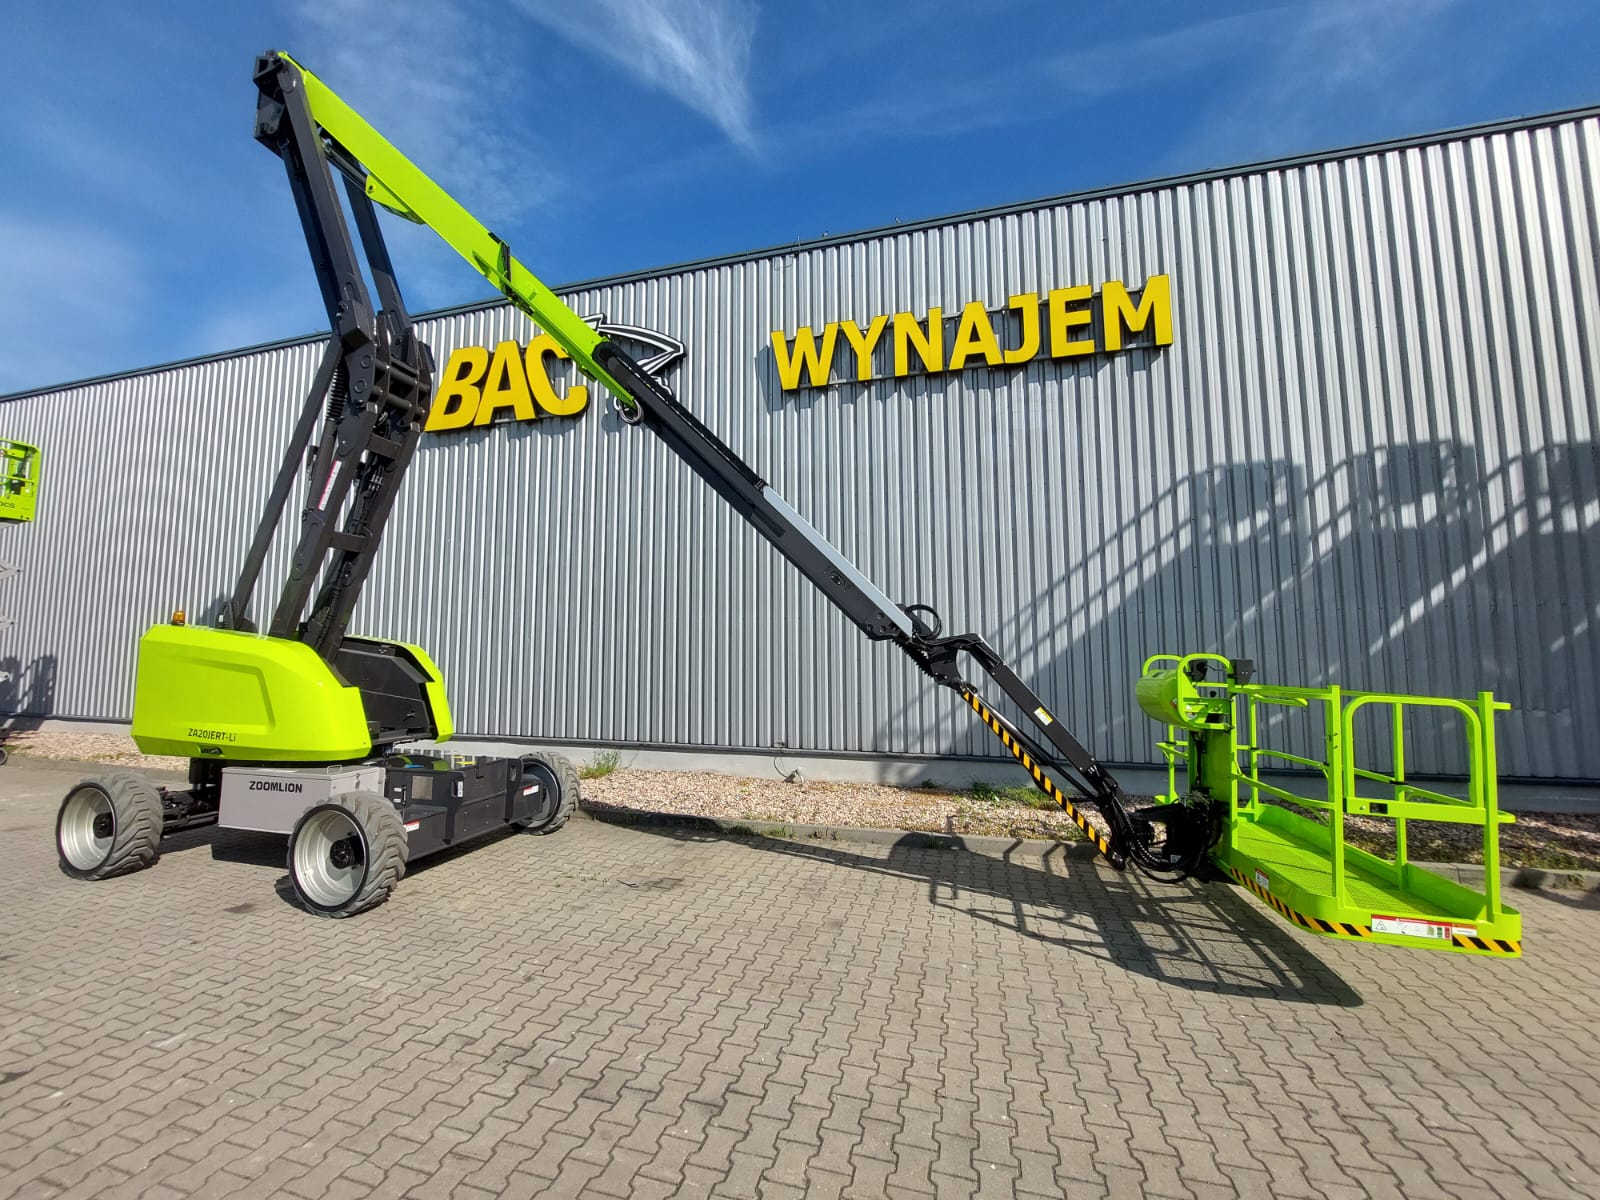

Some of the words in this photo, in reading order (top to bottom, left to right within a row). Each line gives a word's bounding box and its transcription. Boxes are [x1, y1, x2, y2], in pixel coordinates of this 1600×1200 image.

[771, 274, 1173, 391] WYNAJEM
[424, 334, 588, 432] BAC
[188, 728, 238, 742] ZA20JERT-Li
[249, 780, 303, 793] ZOOMLION
